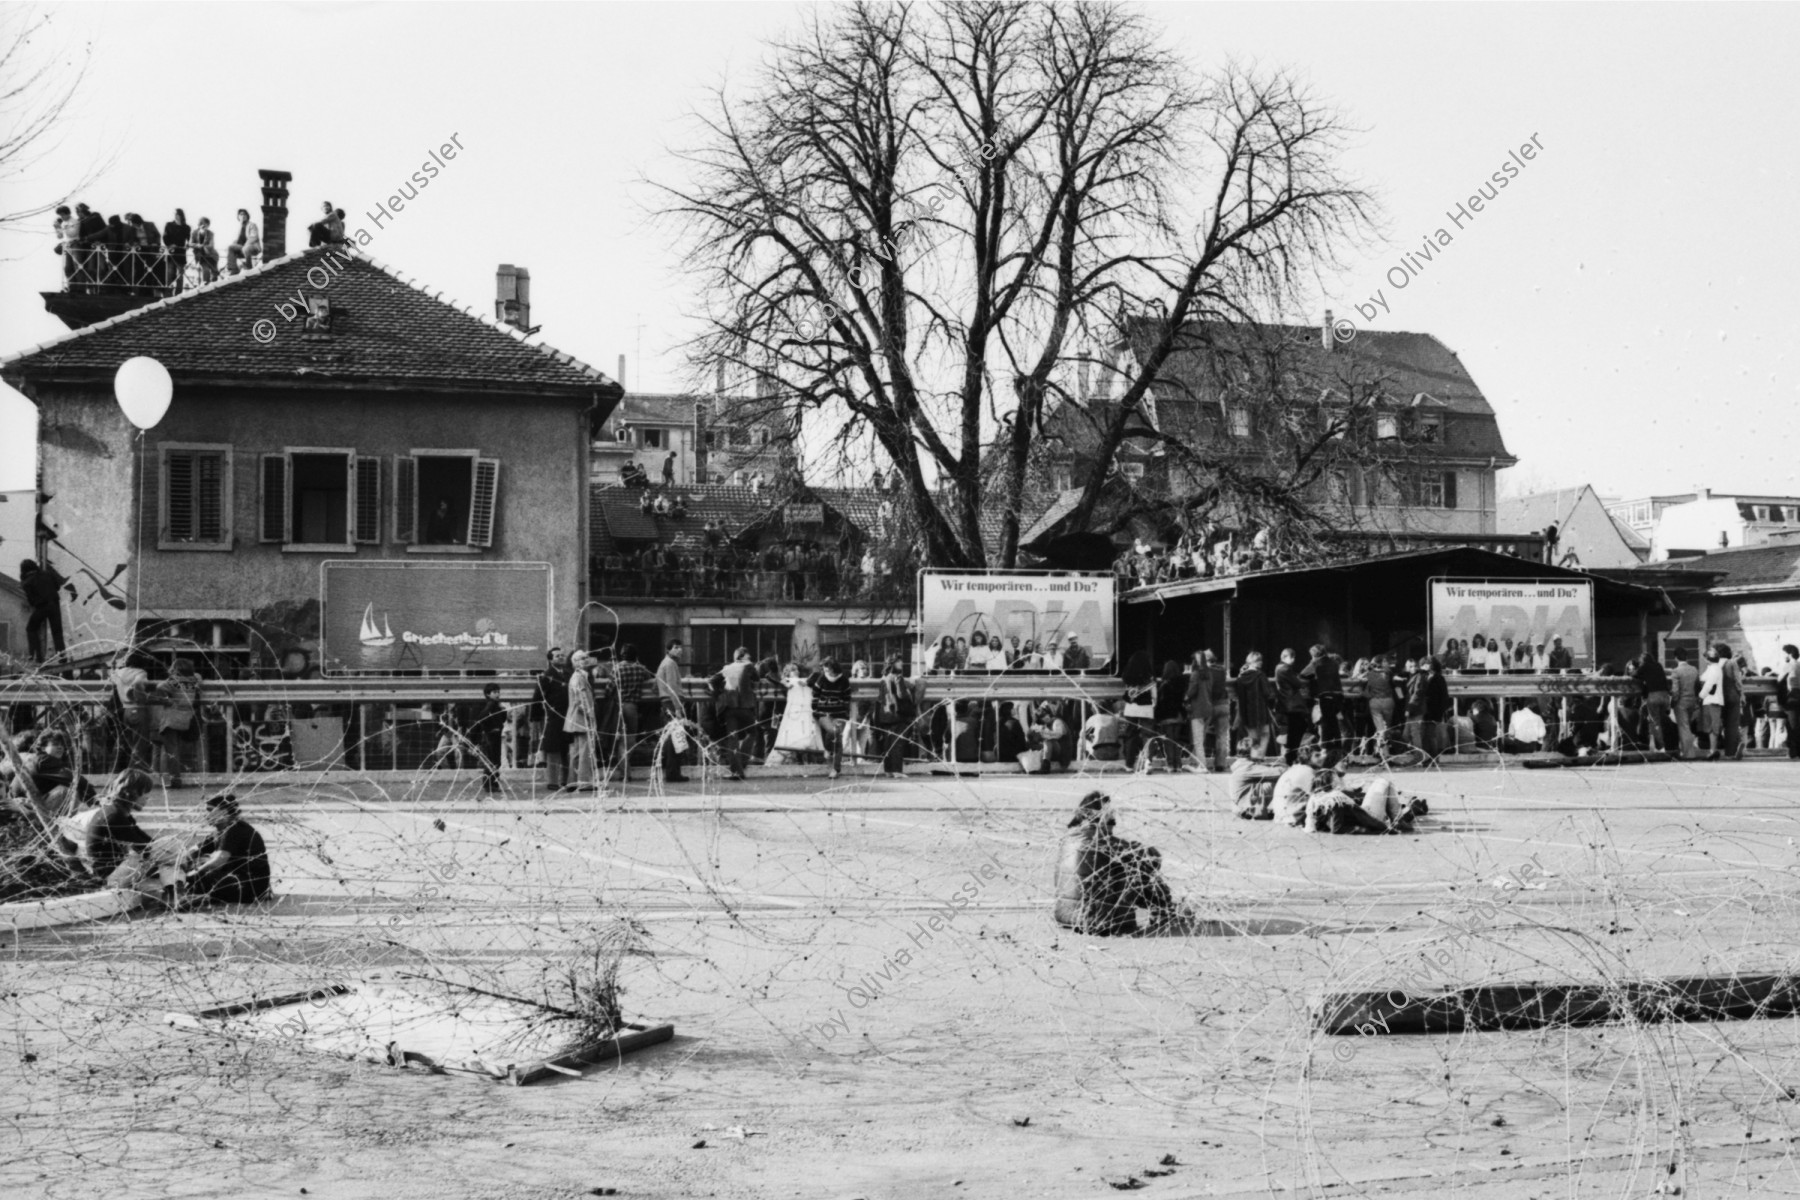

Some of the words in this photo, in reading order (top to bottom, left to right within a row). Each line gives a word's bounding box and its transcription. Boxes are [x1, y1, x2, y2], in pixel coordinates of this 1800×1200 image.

[941, 579, 964, 591] Wir
[1074, 581, 1098, 592] Du?
[1446, 587, 1466, 597] Wir
[1557, 587, 1577, 598] Du?
